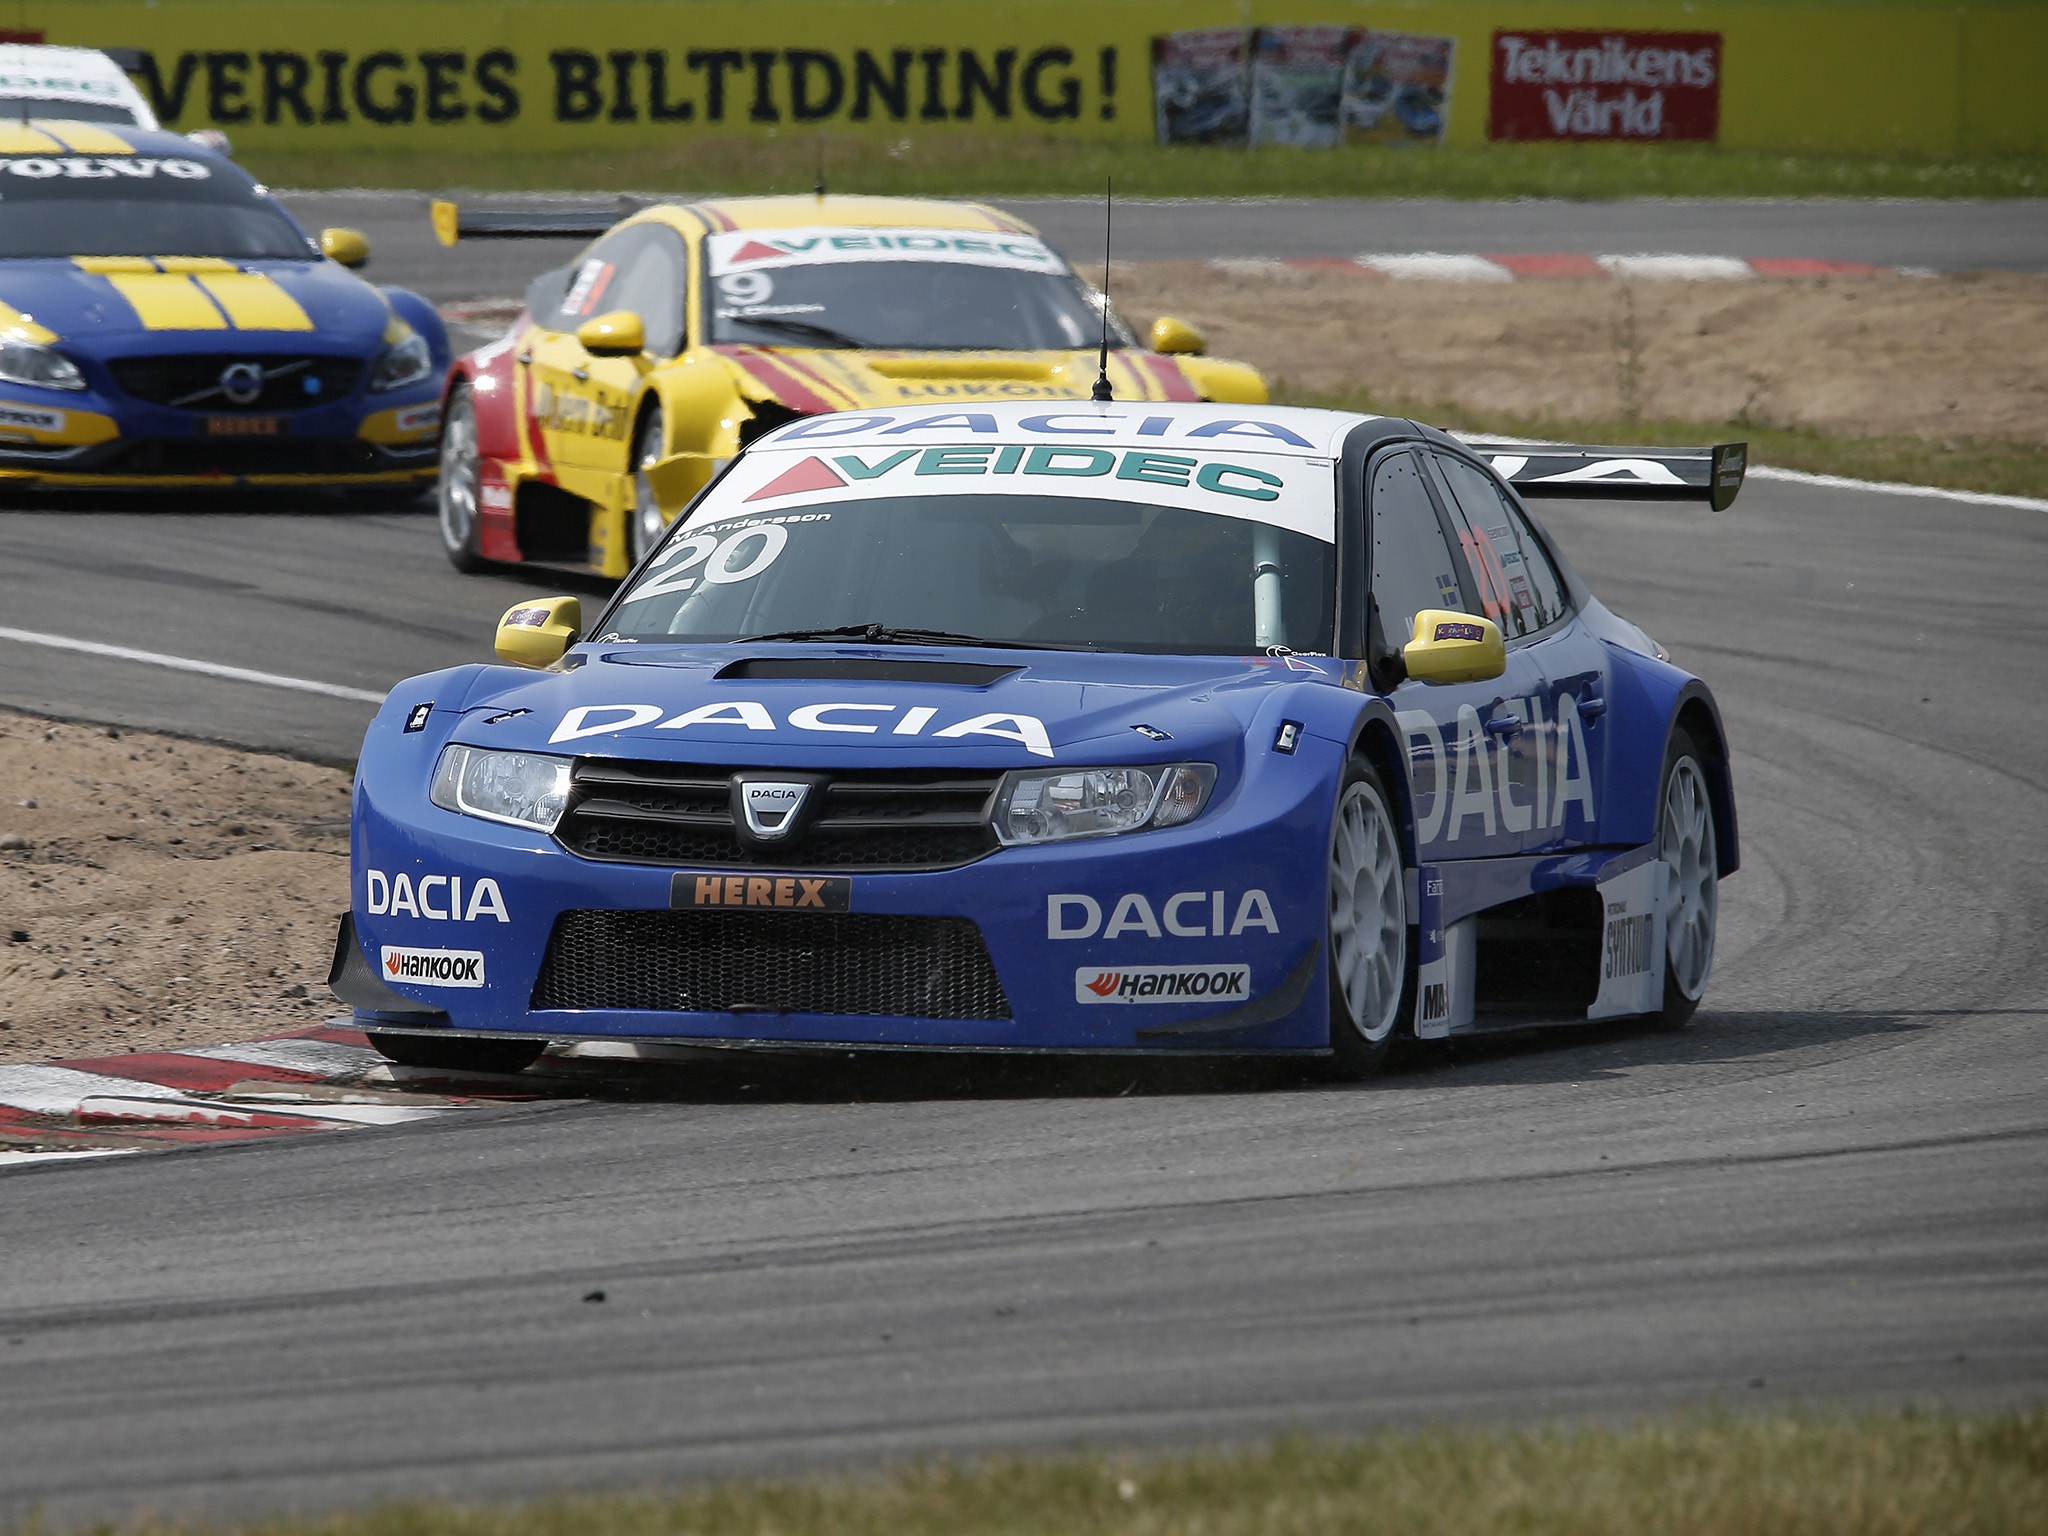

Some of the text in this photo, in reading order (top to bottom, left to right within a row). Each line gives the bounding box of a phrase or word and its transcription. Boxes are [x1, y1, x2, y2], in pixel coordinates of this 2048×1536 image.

[1500, 35, 1714, 87] Teknikens
[137, 49, 520, 125] VERIGES
[1544, 88, 1663, 134] Värld
[0, 158, 211, 179] OLVO
[771, 236, 1049, 262] VEIDEC
[719, 270, 774, 305] 9
[773, 414, 1317, 449] DACIA
[831, 446, 1283, 501] VEIDEC
[623, 523, 788, 605] 20
[549, 703, 1054, 758] DACIA
[750, 788, 797, 799] DACIA
[1395, 692, 1595, 844] DACIA
[367, 869, 510, 923] DACIA
[694, 876, 828, 907] HEREX
[1048, 889, 1280, 940] DACIA
